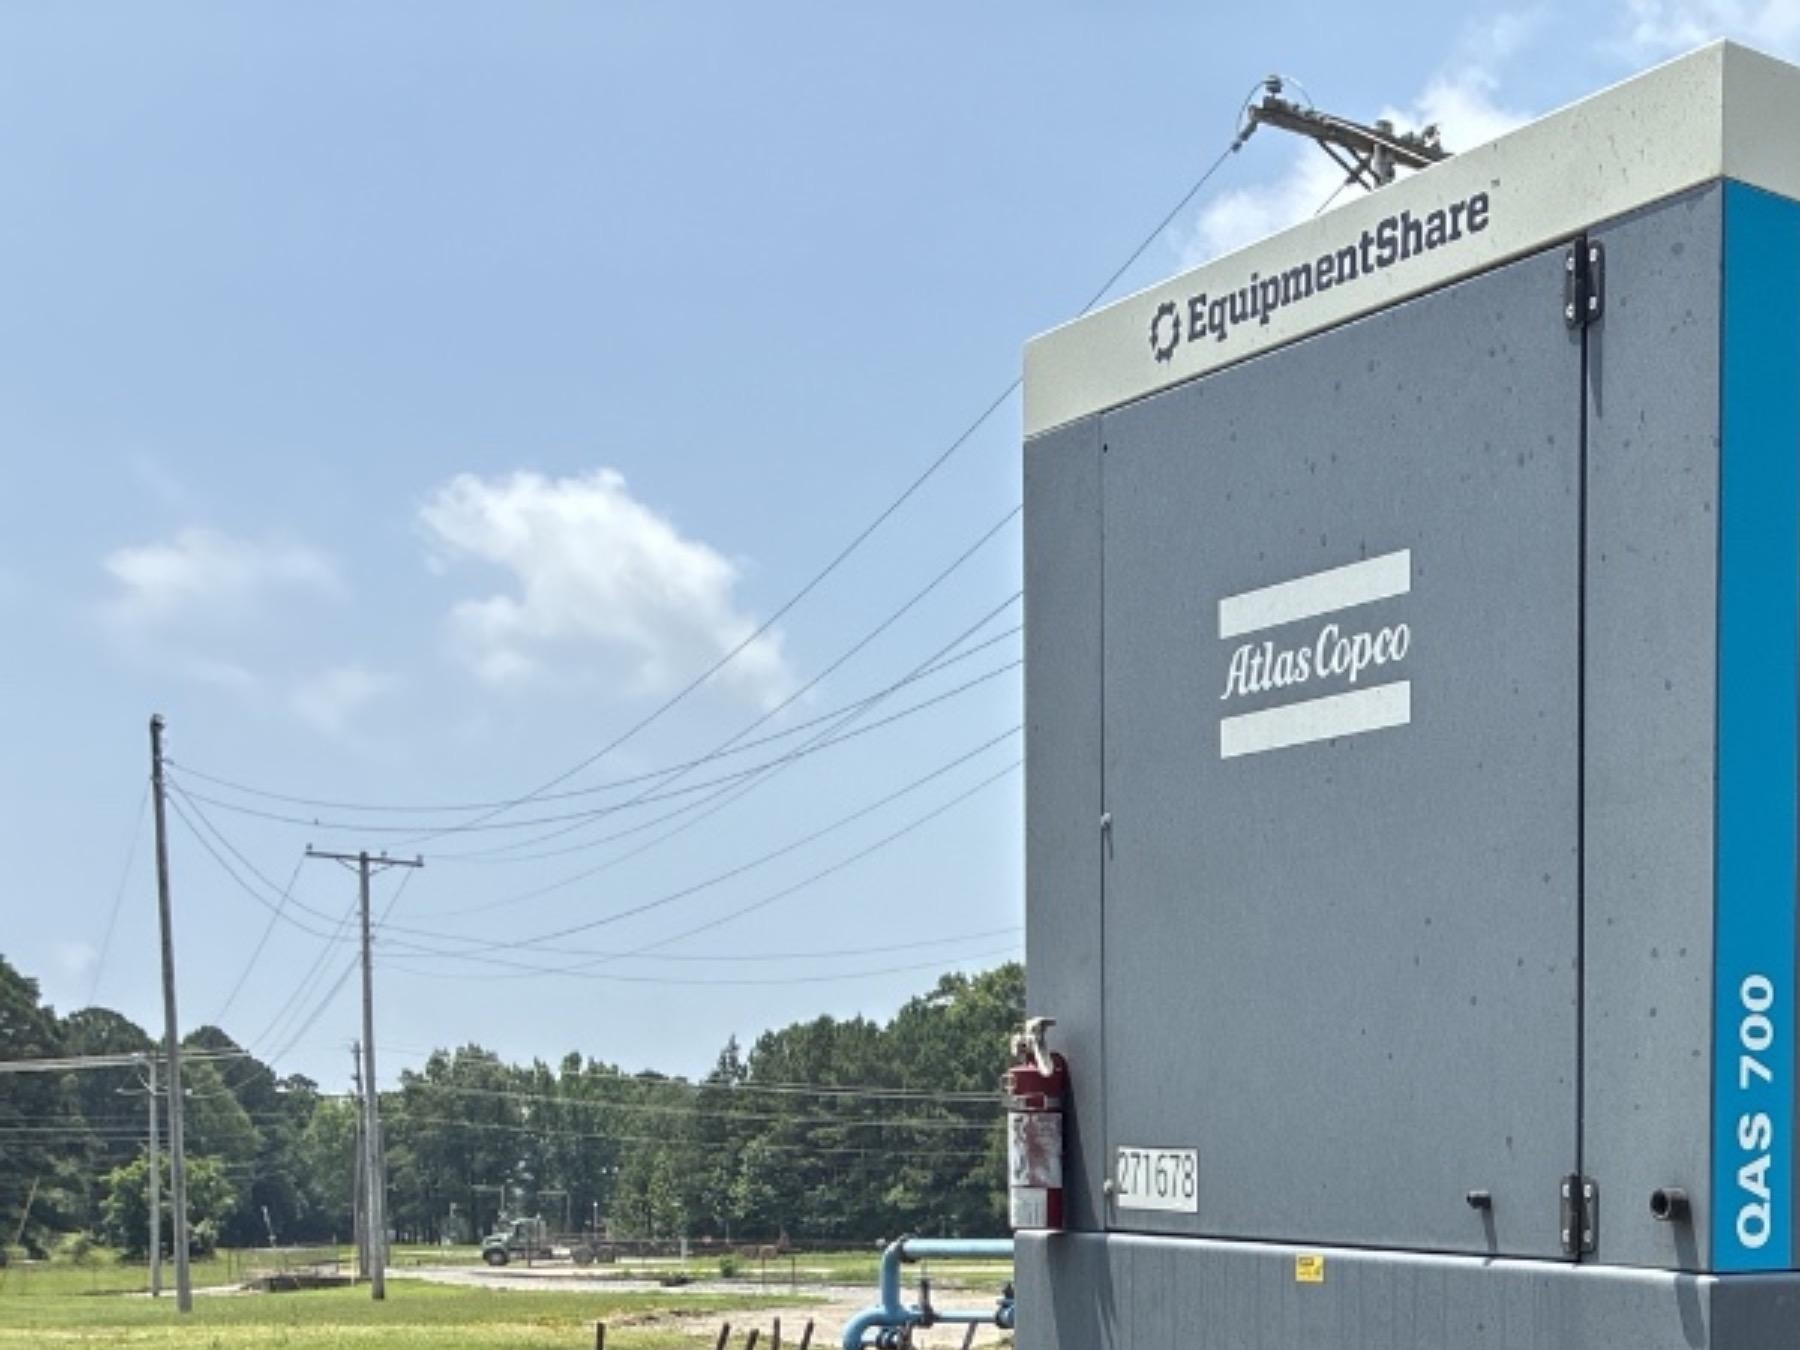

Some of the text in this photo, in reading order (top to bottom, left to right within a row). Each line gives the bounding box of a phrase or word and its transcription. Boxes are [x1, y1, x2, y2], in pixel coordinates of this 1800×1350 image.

[1186, 190, 1491, 343] EquipmentShare
[1220, 623, 1411, 700] Atlas Copco
[1736, 973, 1775, 1249] QAS 700
[1117, 1152, 1195, 1199] 271678
